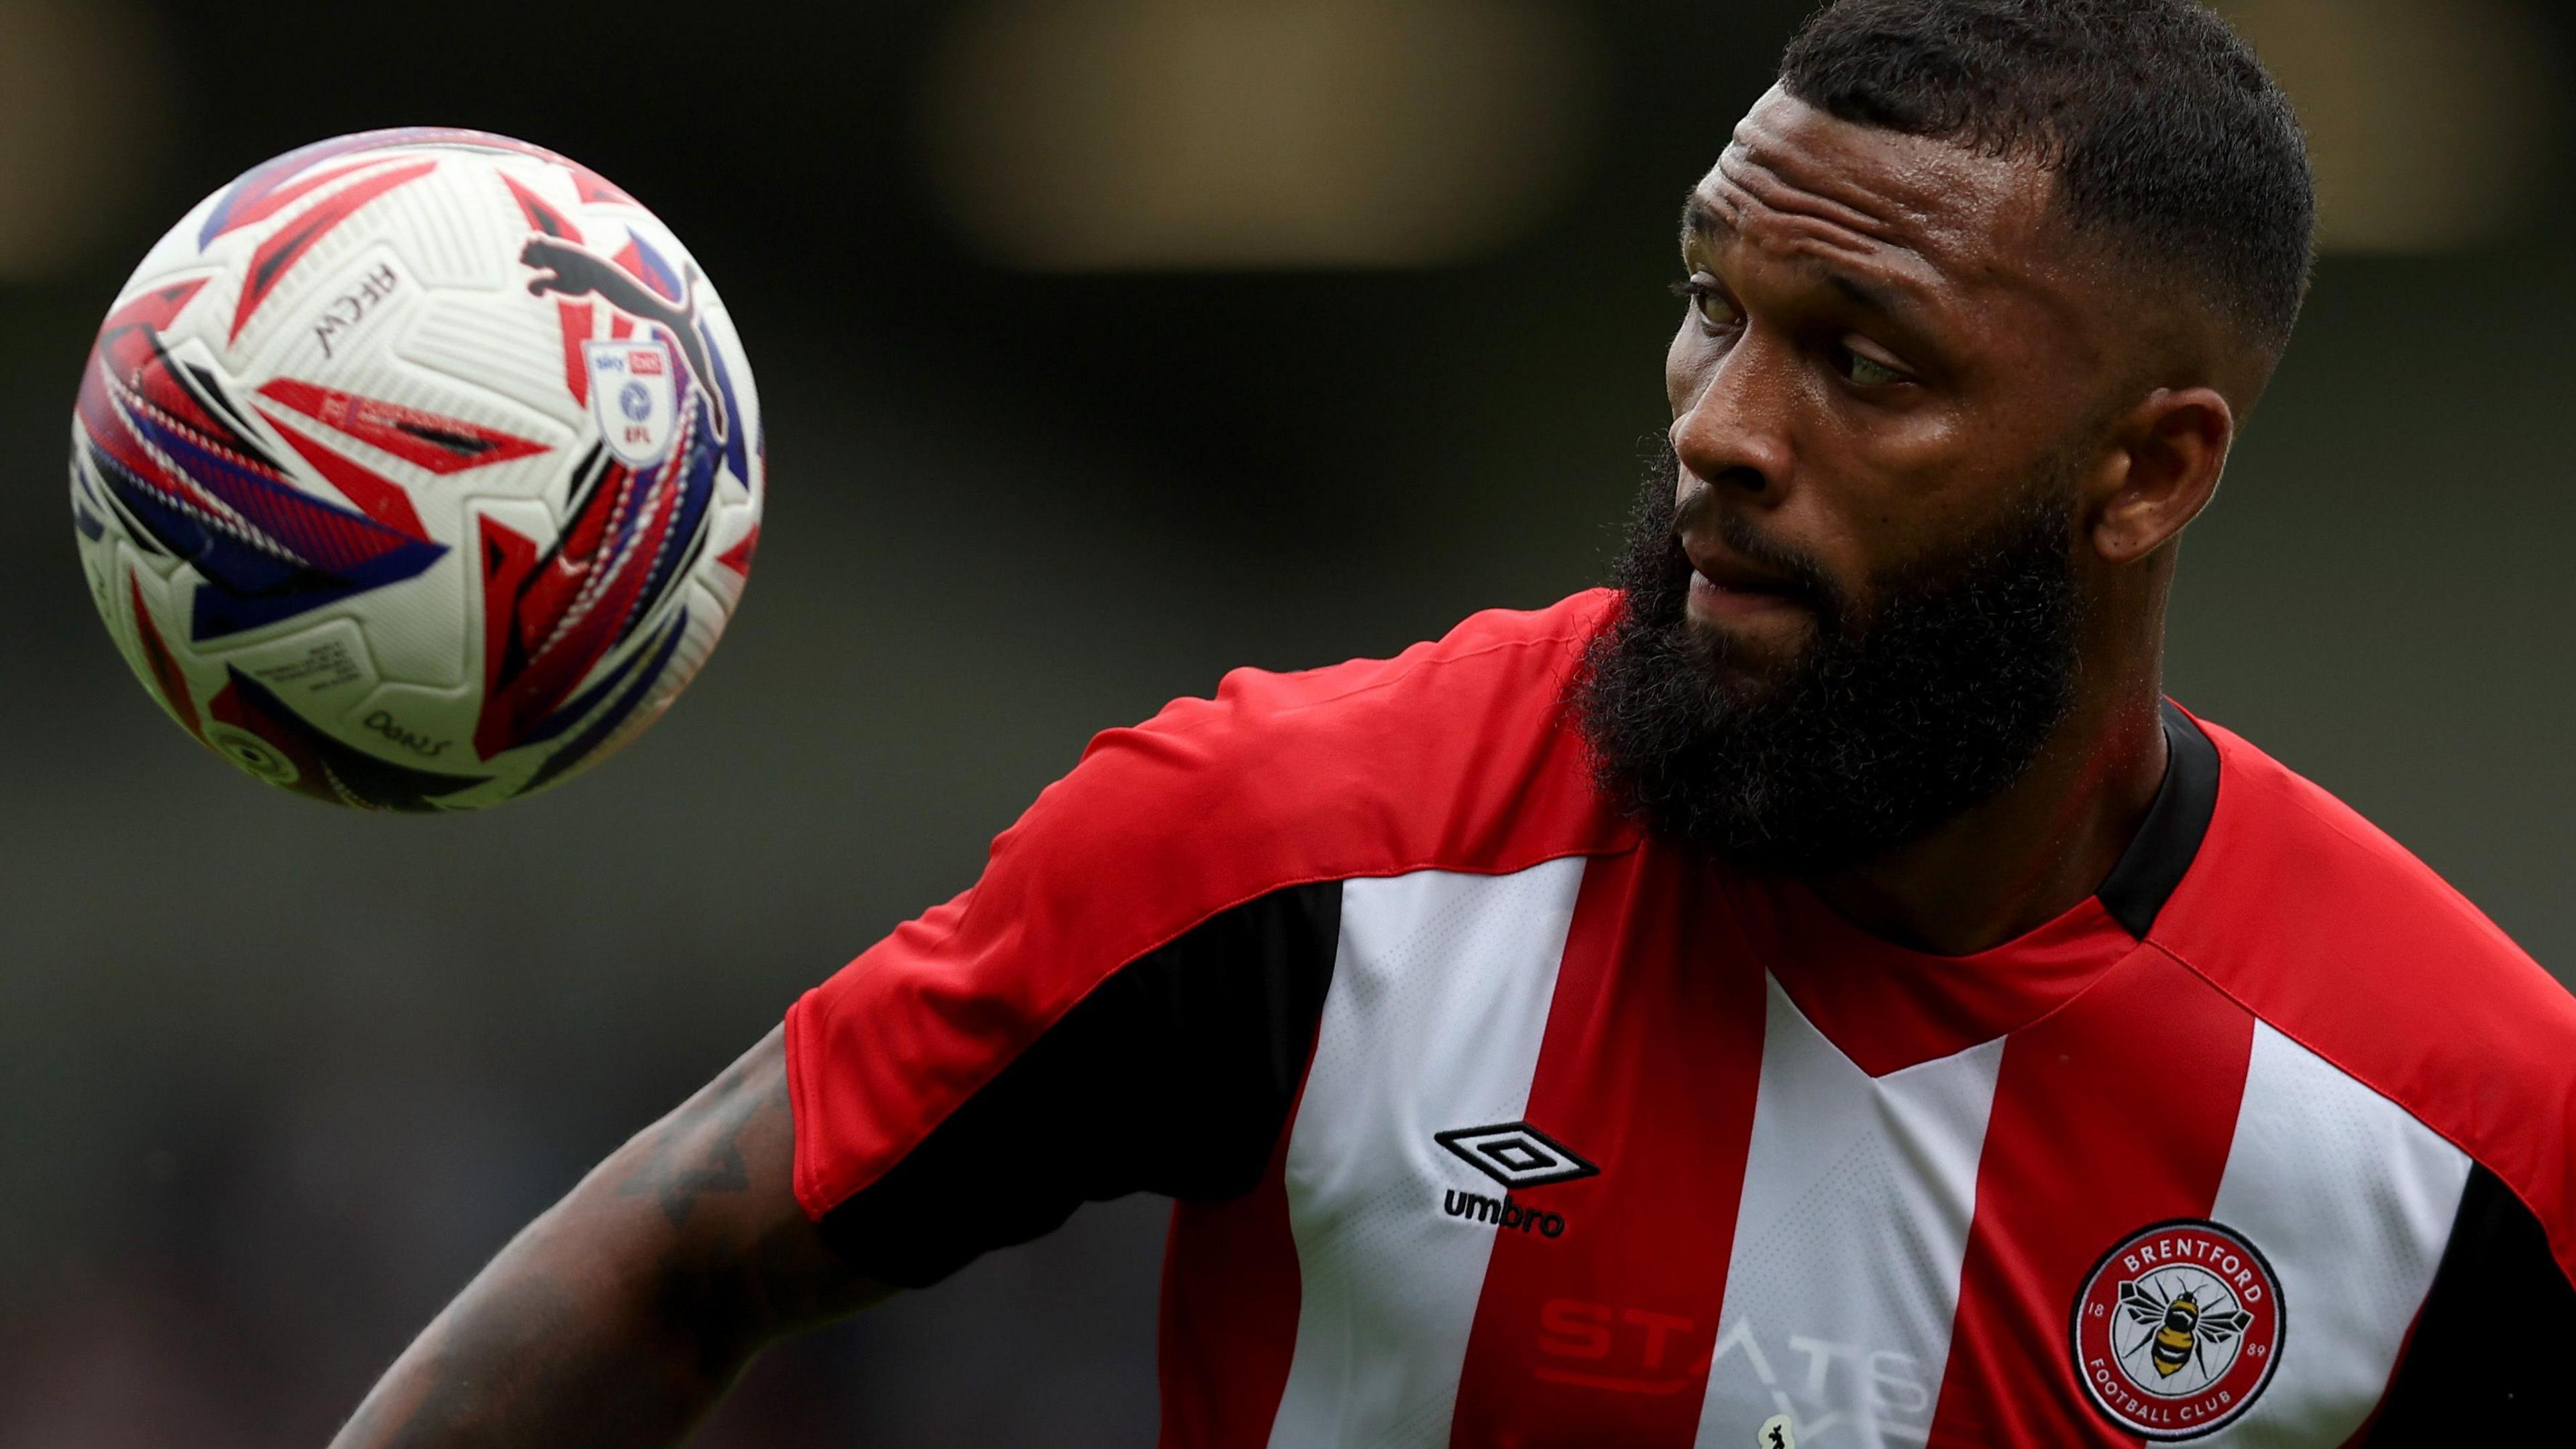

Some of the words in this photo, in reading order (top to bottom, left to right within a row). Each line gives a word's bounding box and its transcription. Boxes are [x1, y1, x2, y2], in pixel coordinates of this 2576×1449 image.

[315, 263, 396, 360] AFCW
[625, 426, 652, 443] EFL
[1444, 1189, 1564, 1238] umbro
[2123, 1239, 2262, 1302] BRENTFORD
[2088, 1302, 2104, 1316] 18
[2247, 1343, 2266, 1357] 89
[2090, 1358, 2171, 1422] FOOTBALL
[2180, 1391, 2231, 1420] CLUB
